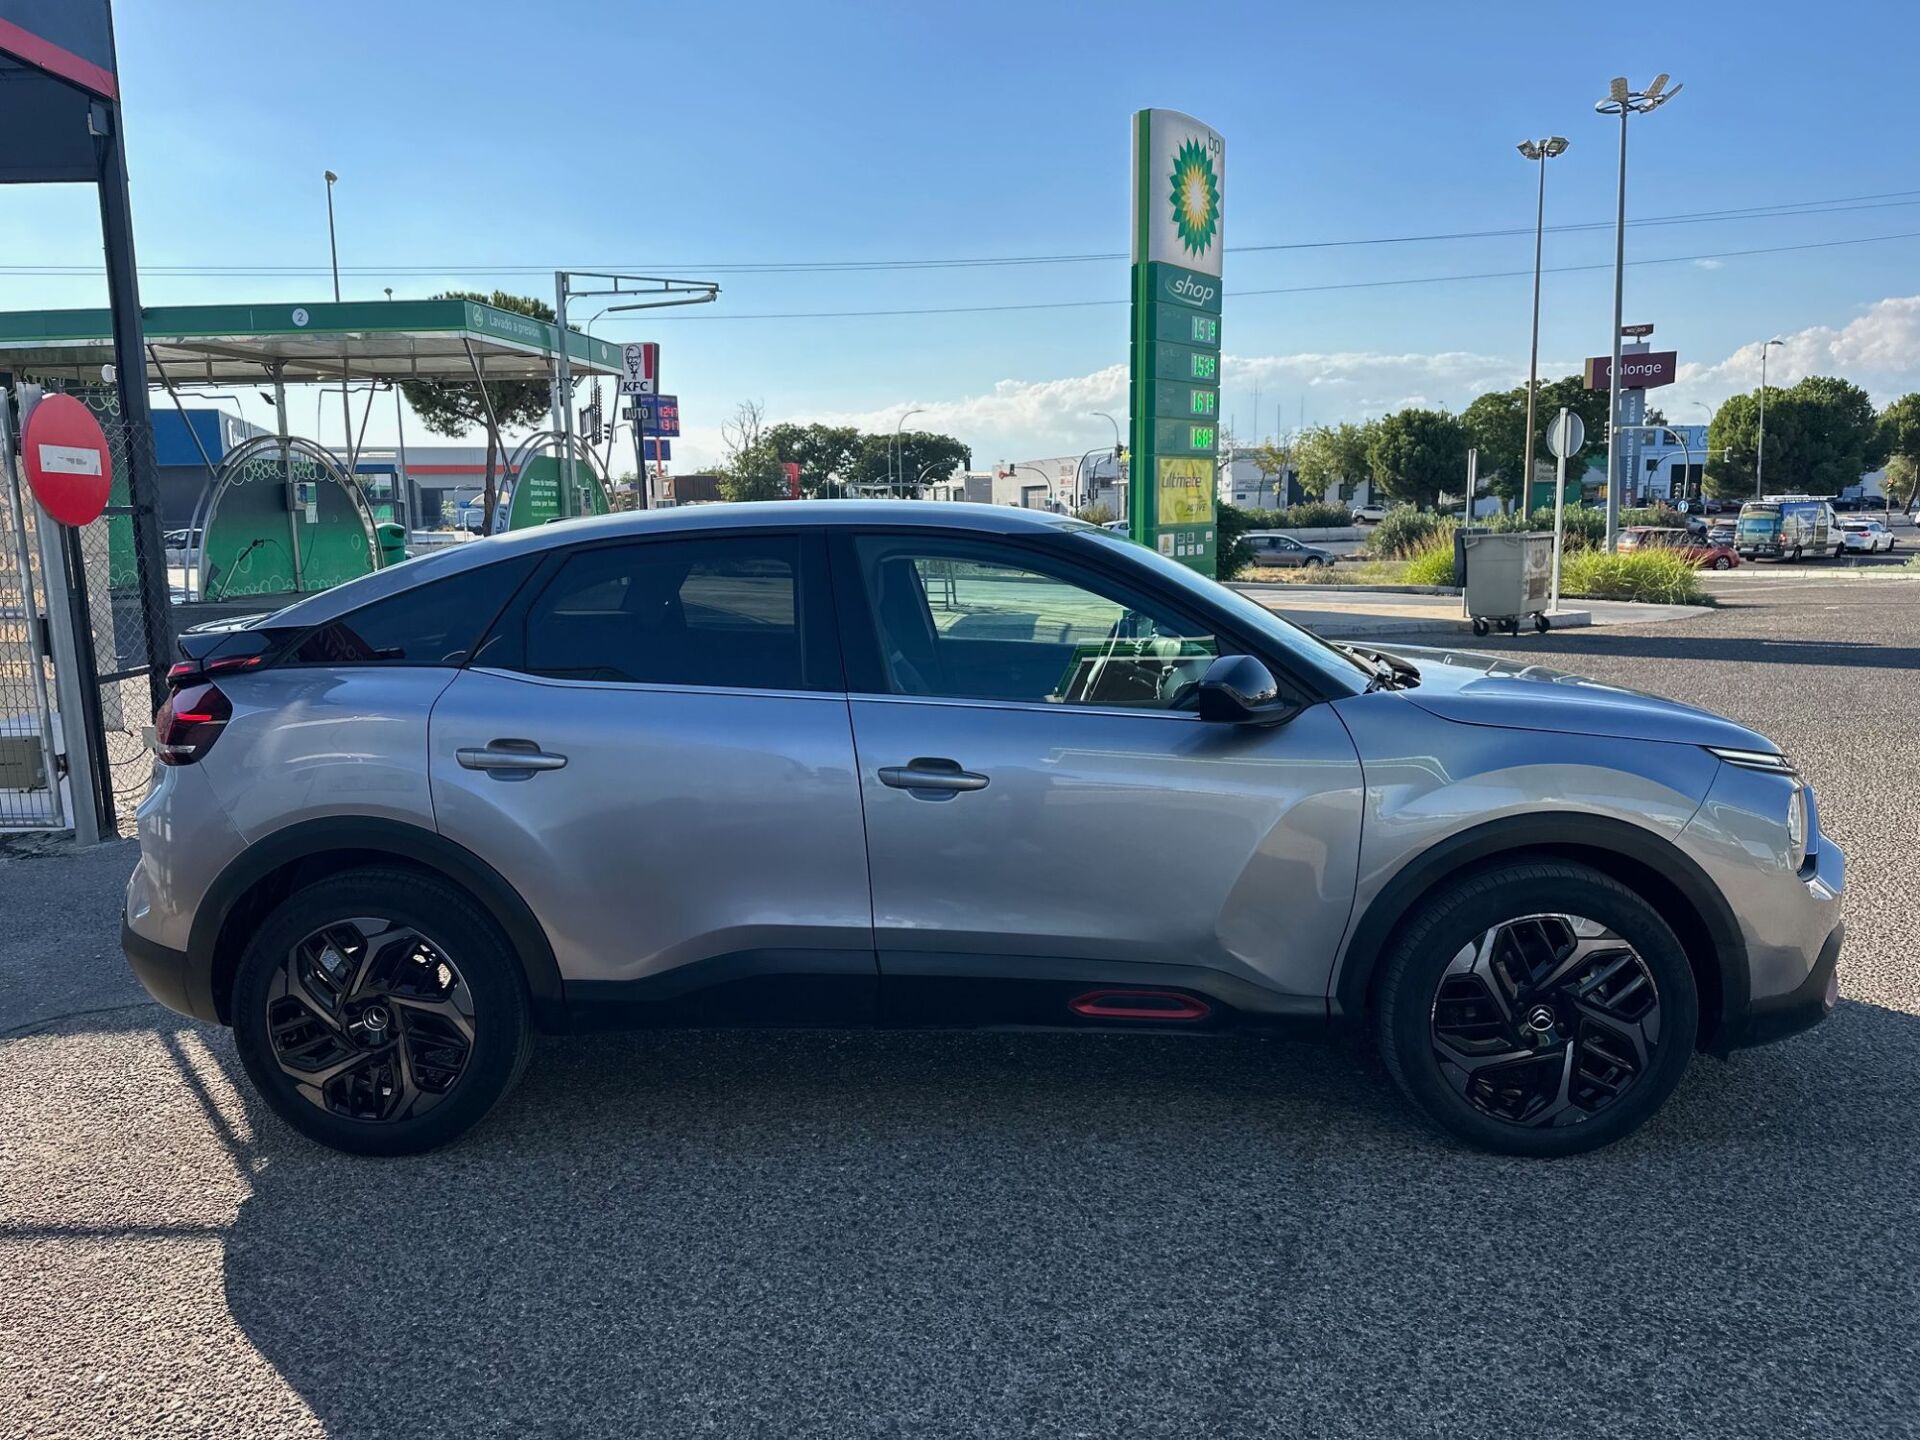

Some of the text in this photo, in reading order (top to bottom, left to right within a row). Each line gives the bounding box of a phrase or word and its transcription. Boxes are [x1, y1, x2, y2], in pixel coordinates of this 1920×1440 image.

[1208, 132, 1221, 158] bp
[1174, 275, 1214, 302] shop
[297, 311, 304, 322] 2
[489, 313, 513, 331] Lavado
[1606, 363, 1662, 376] Clonge
[622, 381, 648, 392] KFC
[625, 408, 649, 419] AUTO
[1625, 438, 1634, 490] EMPRESARIALES
